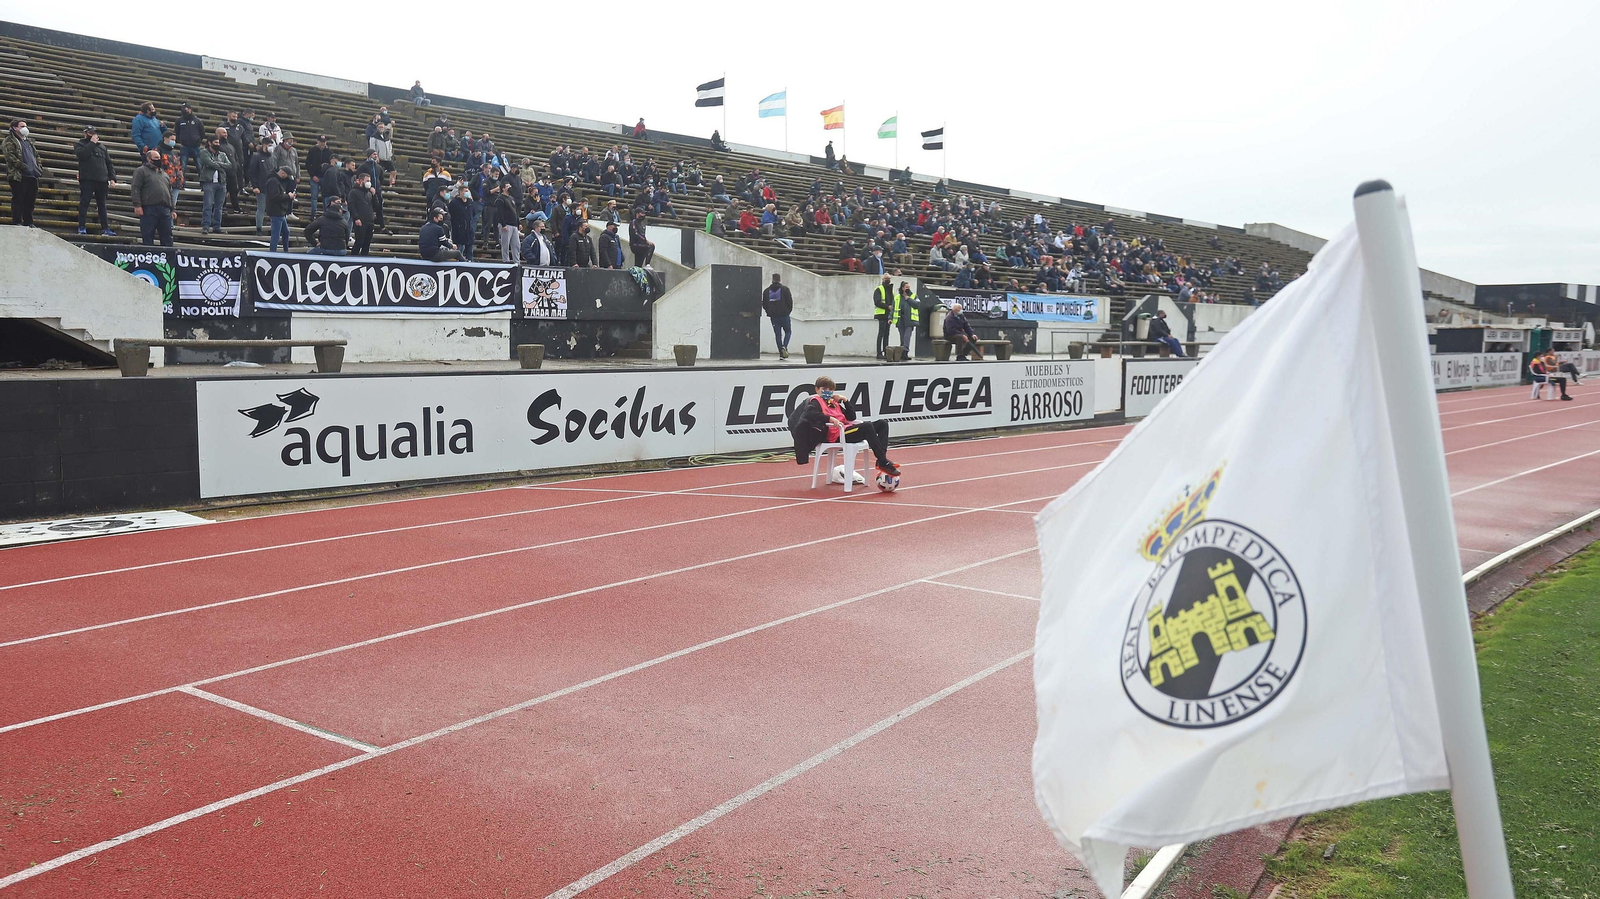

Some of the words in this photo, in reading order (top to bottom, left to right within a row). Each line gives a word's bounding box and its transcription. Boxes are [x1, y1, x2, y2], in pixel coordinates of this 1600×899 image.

[177, 254, 242, 269] ULTRAS
[523, 269, 564, 279] BALONA
[254, 258, 405, 306] COLECTIVO
[436, 269, 513, 307] DOCE
[180, 306, 200, 316] NO
[530, 308, 549, 317] NADA
[551, 309, 567, 317] MAS
[1021, 300, 1044, 314] BALONA
[1025, 365, 1064, 377] MUEBLES
[1065, 364, 1071, 375] Y
[1011, 377, 1084, 390] ELECTRODOMESTICOS
[725, 382, 872, 426] LEA
[879, 376, 992, 412] LEGEA
[1010, 390, 1083, 422] BARROSO
[527, 385, 696, 445] Socibus
[281, 405, 474, 477] aqualia
[1168, 662, 1287, 722] LINENSE
